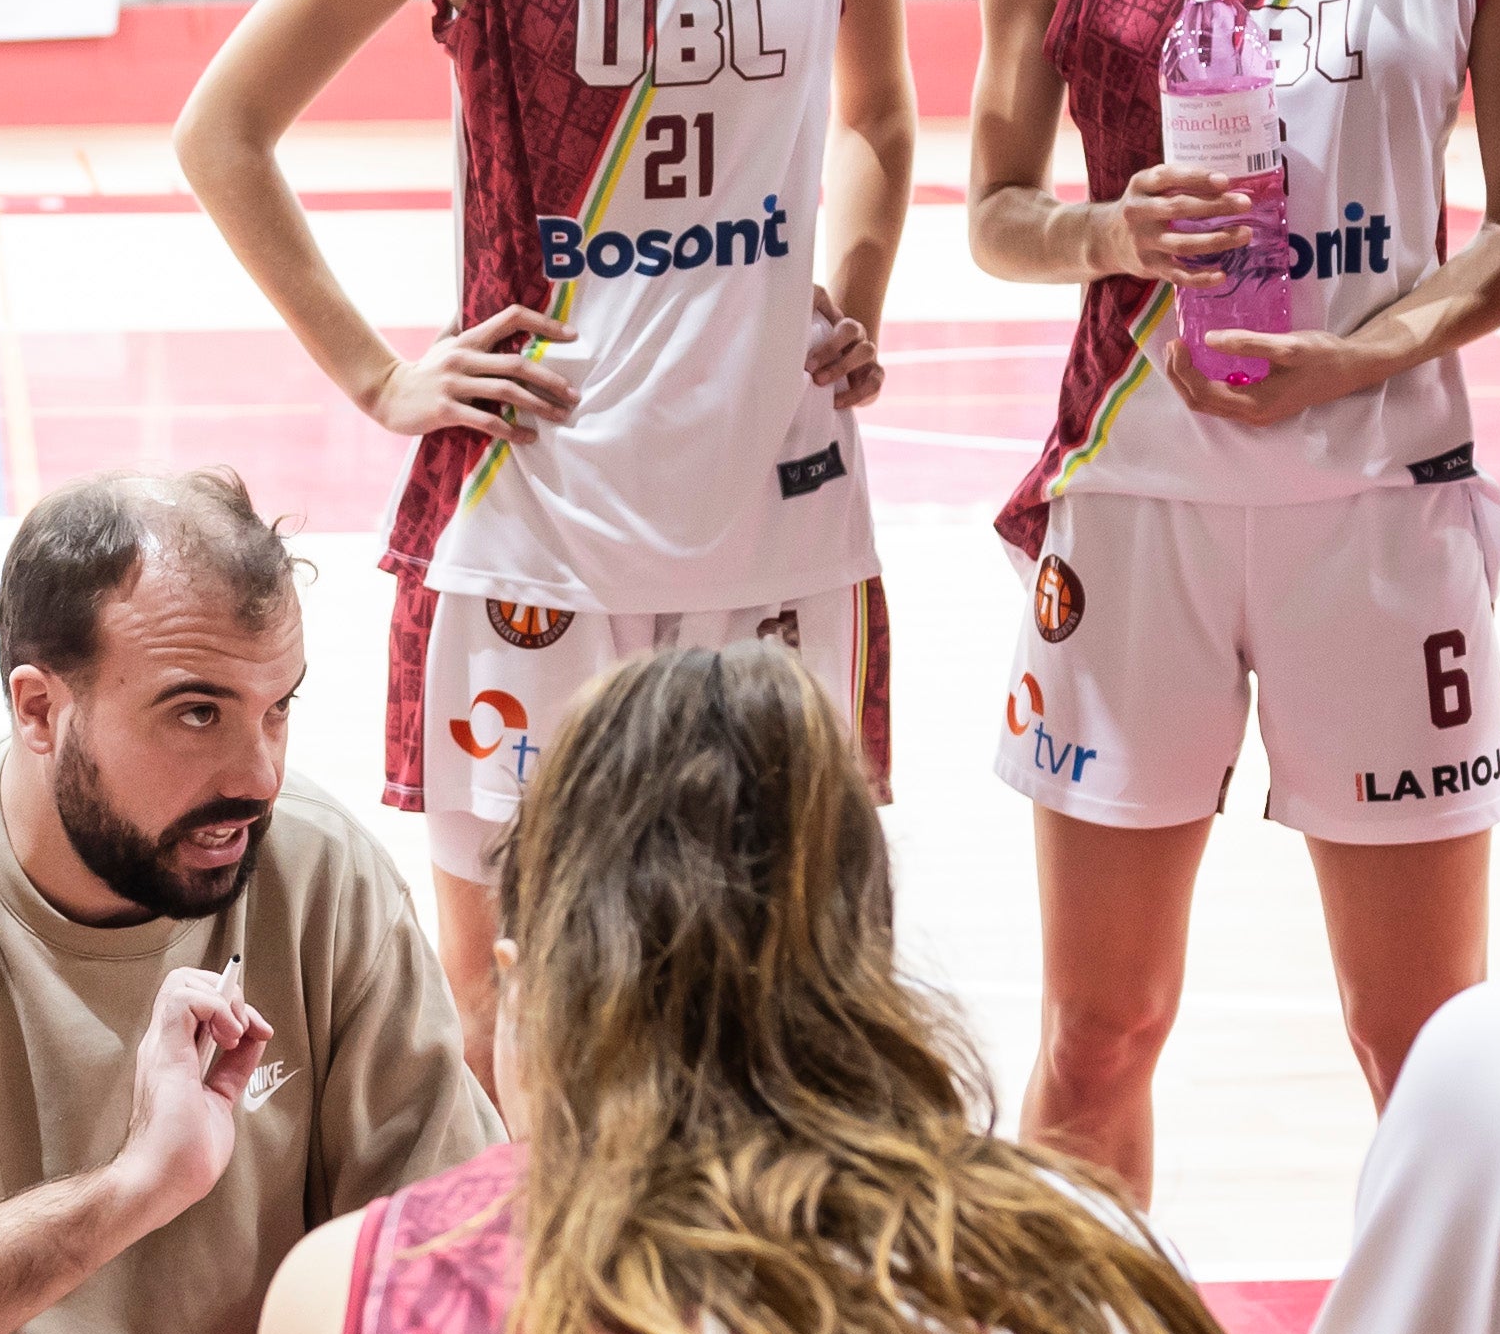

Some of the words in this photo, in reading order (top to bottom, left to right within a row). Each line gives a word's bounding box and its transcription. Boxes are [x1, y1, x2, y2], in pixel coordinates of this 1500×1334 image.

[644, 111, 714, 200] 21
[1422, 628, 1473, 731] 6
[1033, 721, 1098, 784] tvr
